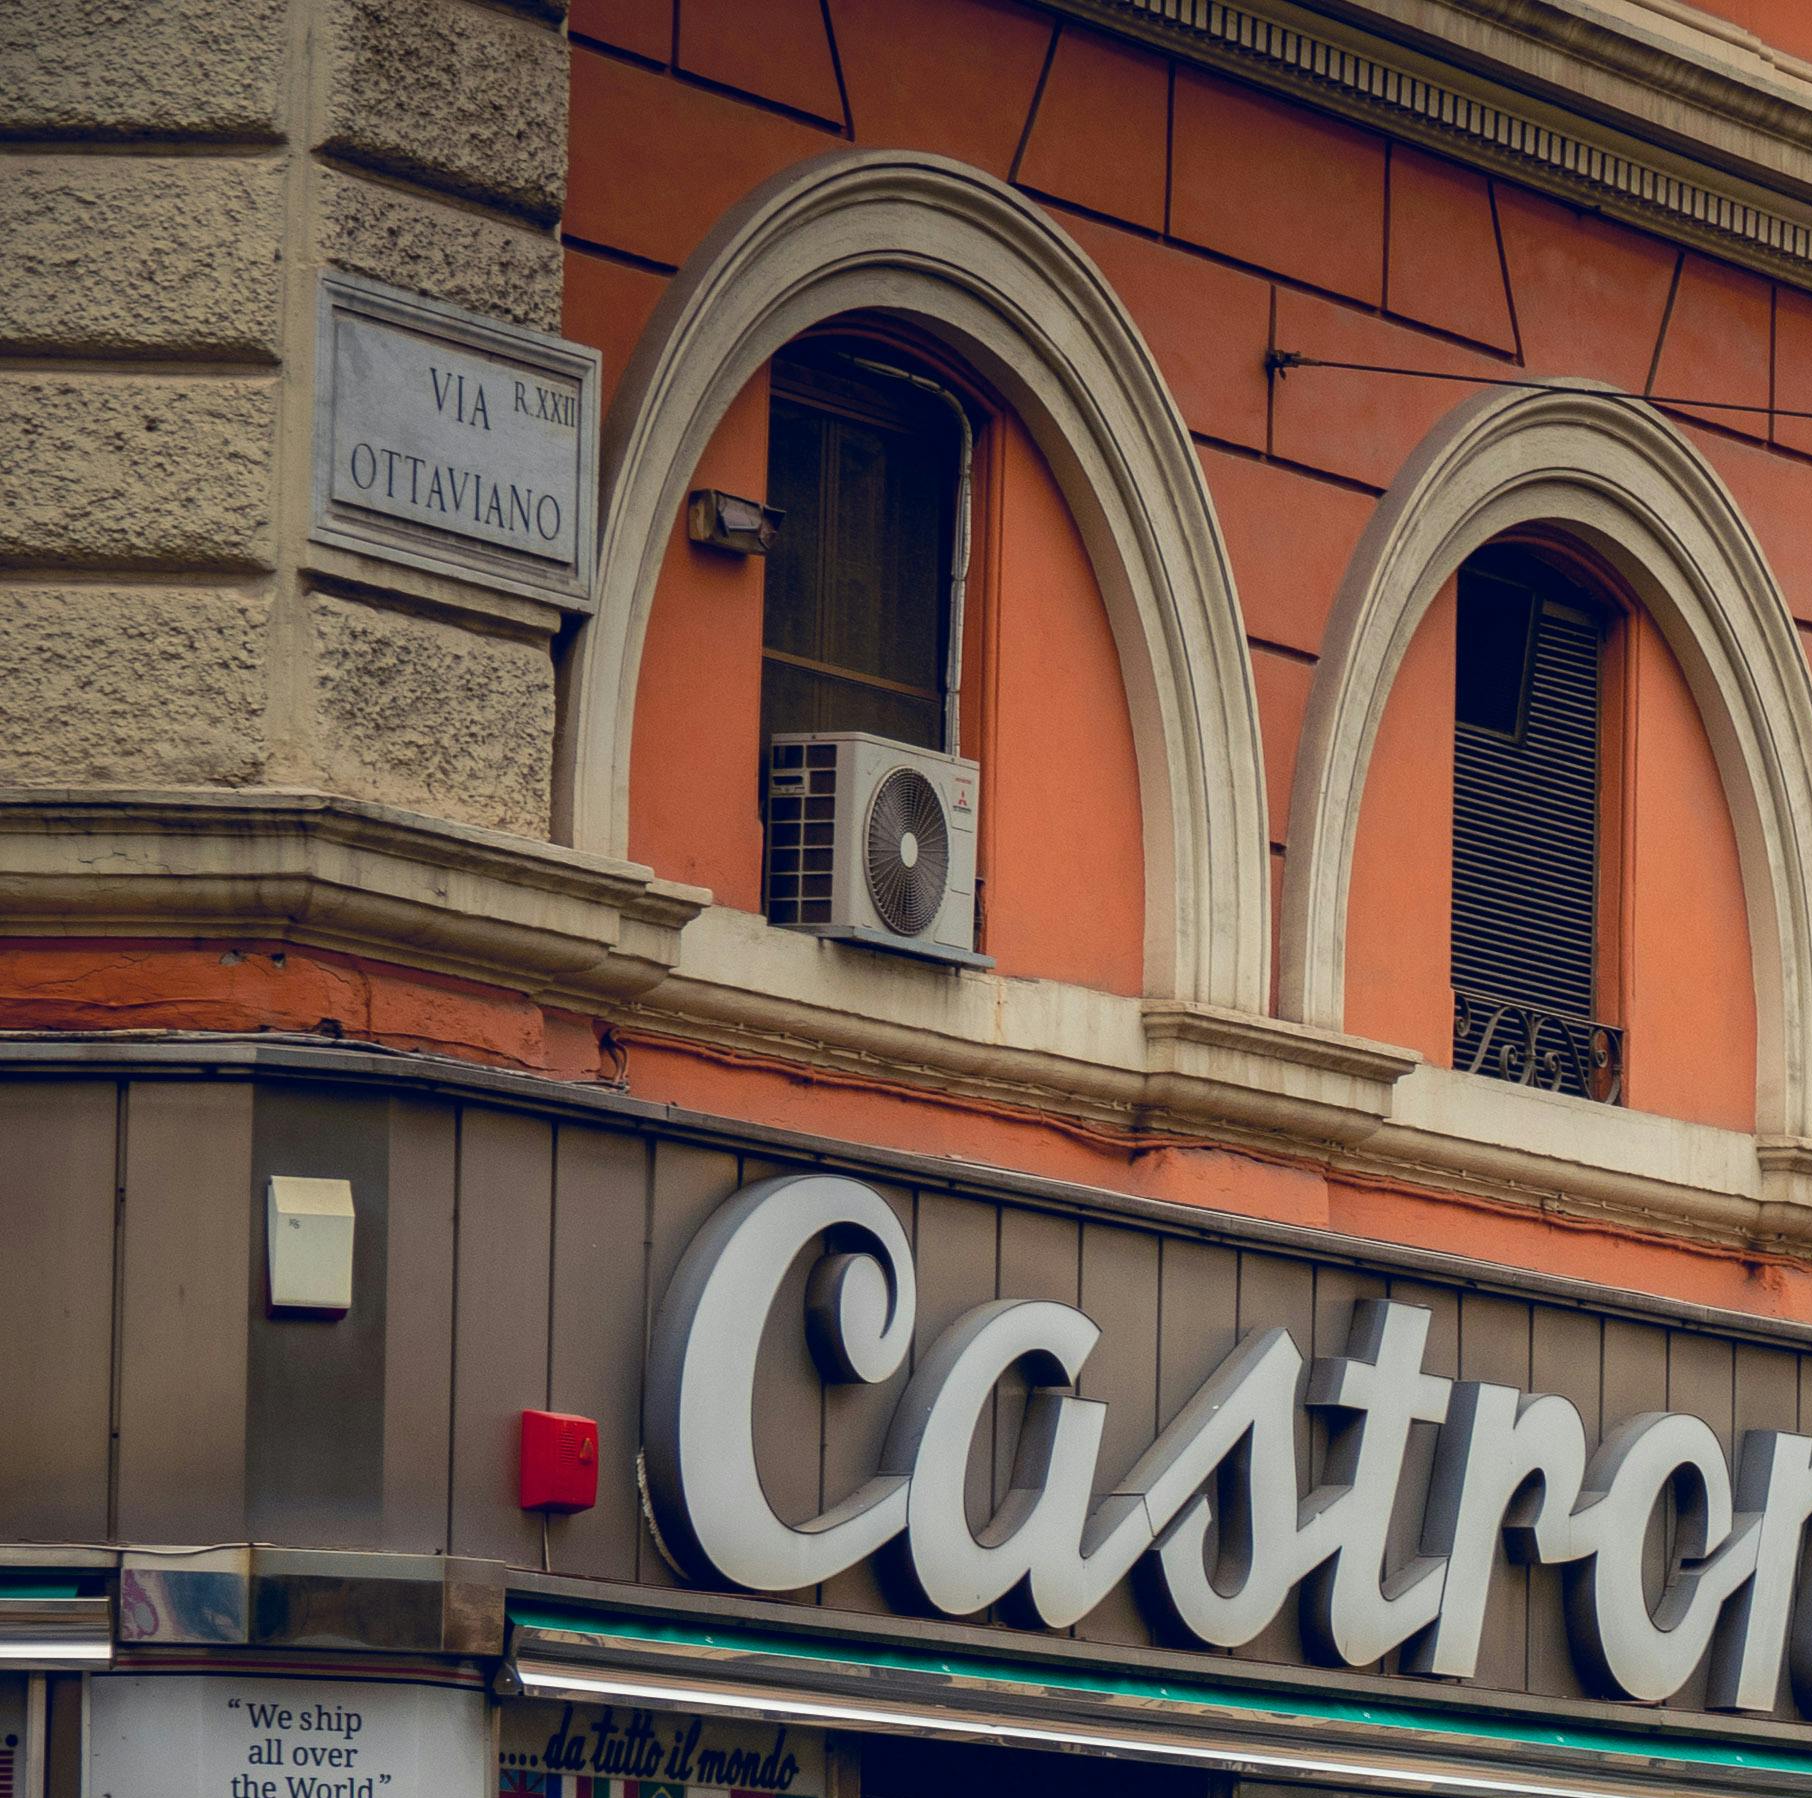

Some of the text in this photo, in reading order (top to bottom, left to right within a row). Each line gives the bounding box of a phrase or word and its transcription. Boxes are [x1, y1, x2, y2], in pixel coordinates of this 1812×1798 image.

[429, 367, 491, 431] VIA
[350, 442, 561, 541] OTTAVIANO
[248, 1738, 359, 1768] all over
[299, 1704, 363, 1740] ship
[590, 1704, 665, 1779] tutto
[664, 1714, 702, 1782] il
[697, 1722, 800, 1792] mondo
